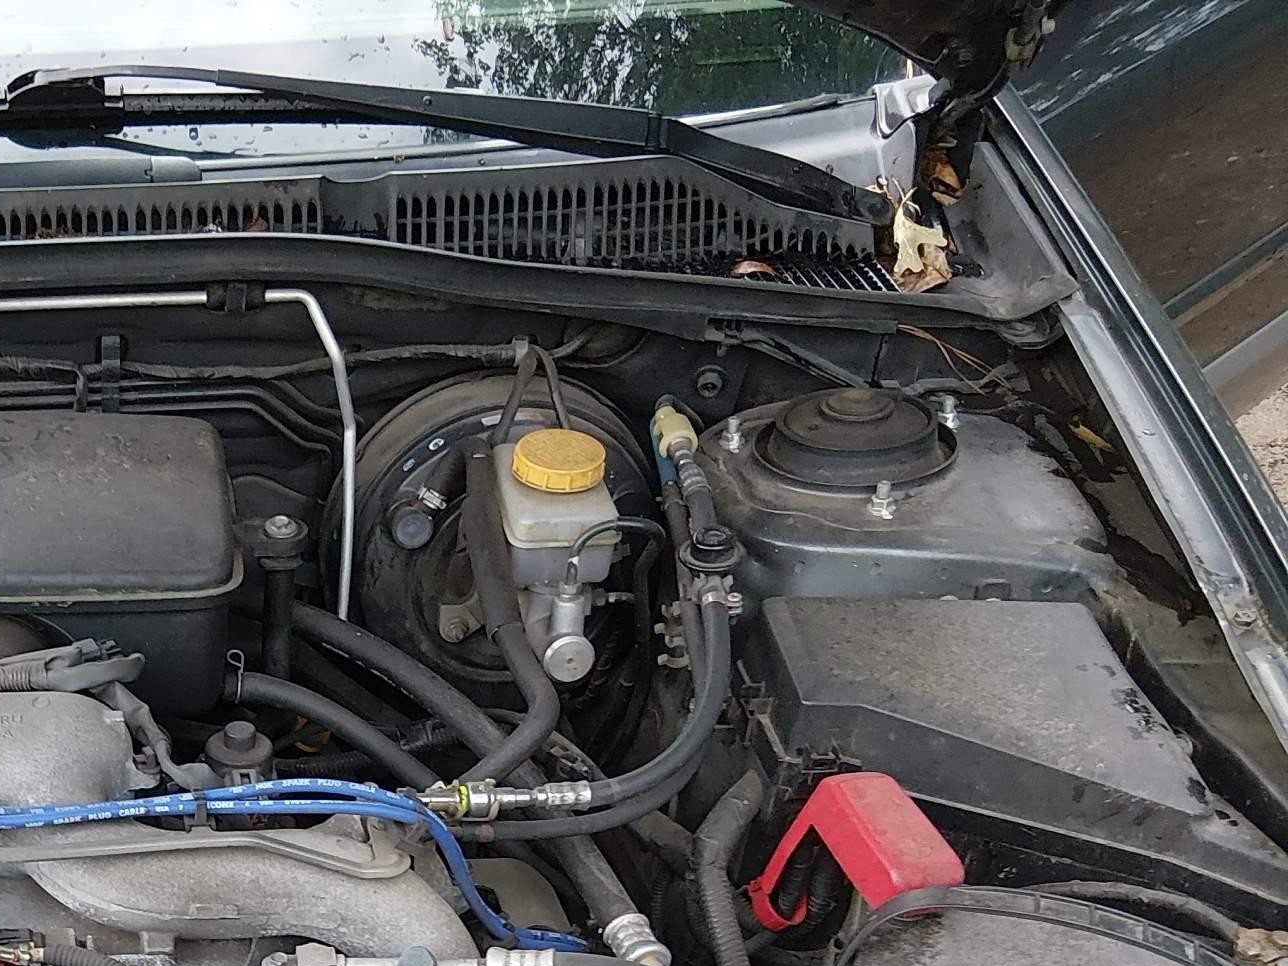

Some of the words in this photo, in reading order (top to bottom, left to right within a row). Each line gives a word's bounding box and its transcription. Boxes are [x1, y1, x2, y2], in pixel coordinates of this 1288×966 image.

[281, 778, 312, 788] SPARK
[317, 778, 342, 788] PLUG
[52, 815, 83, 826] SPARK
[88, 811, 113, 822] PLUG
[118, 805, 149, 817] CABLE
